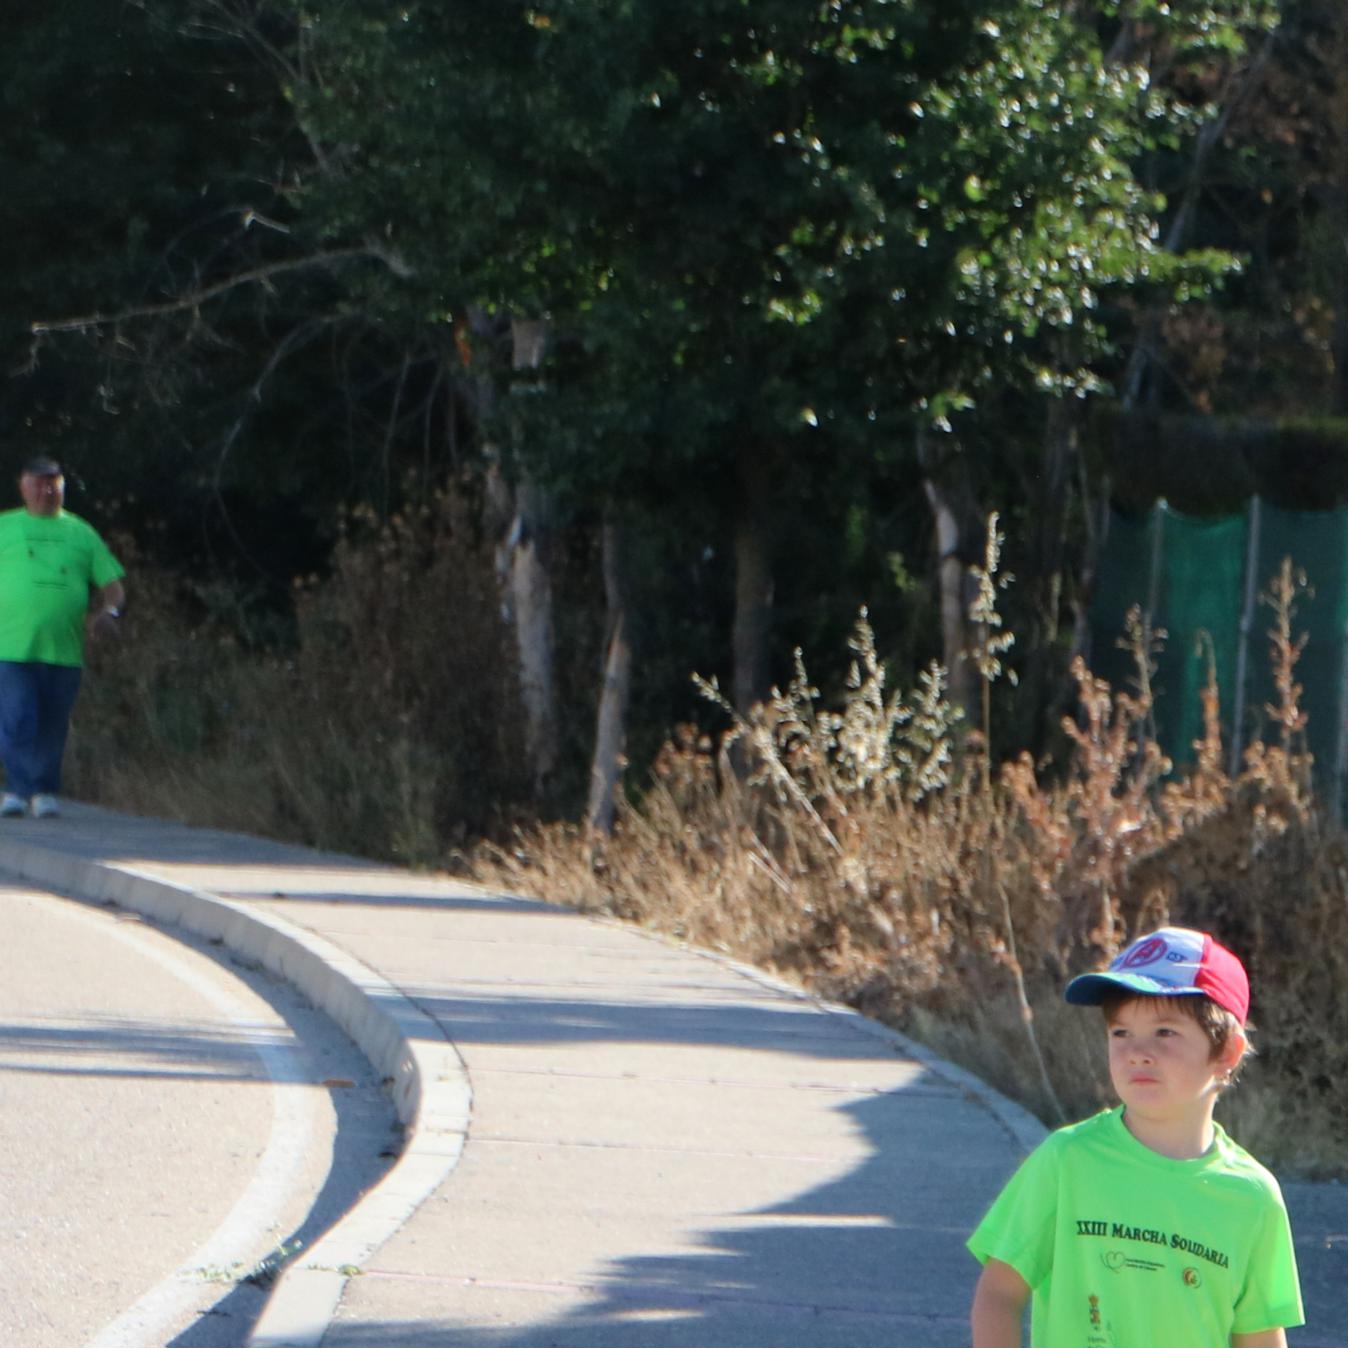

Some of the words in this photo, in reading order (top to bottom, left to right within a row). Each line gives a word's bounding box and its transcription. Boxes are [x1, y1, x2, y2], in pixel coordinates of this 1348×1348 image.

[1076, 1220, 1107, 1236] XXIII
[1111, 1223, 1167, 1246] MARCHA
[1170, 1233, 1229, 1269] SOLIDARIA
